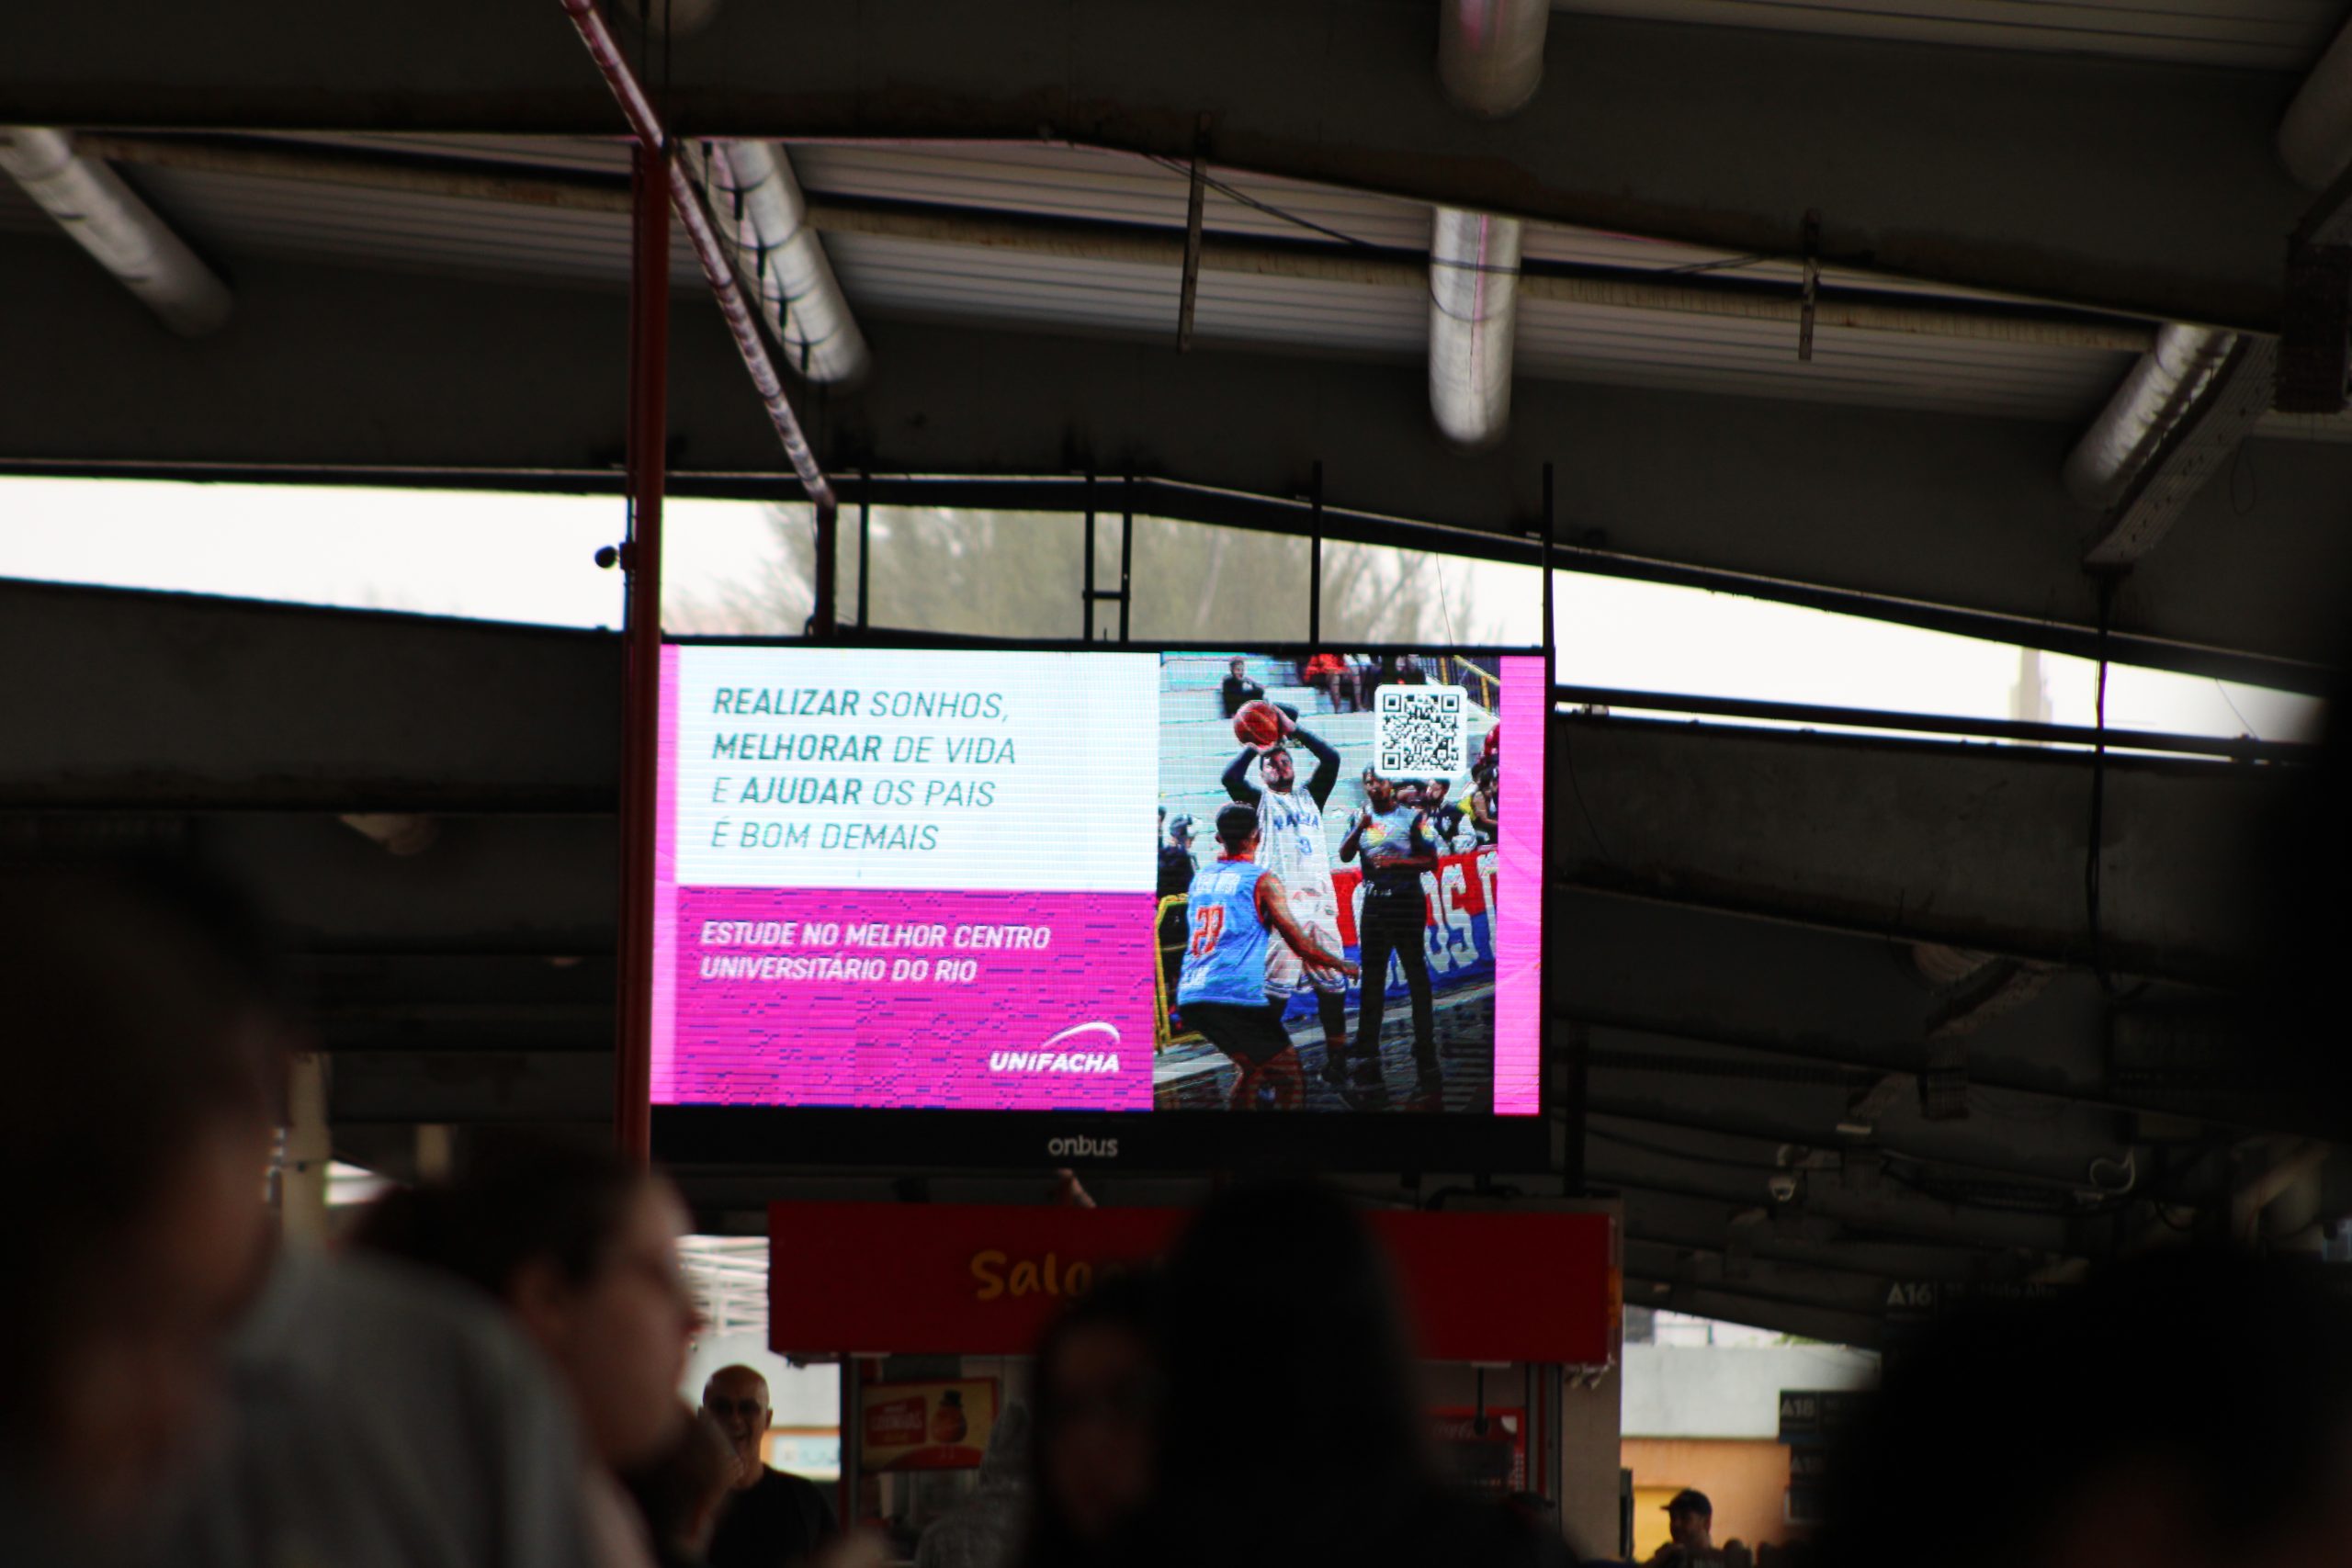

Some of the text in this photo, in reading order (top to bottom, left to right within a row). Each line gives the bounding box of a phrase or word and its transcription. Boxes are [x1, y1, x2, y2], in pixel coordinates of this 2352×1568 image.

[714, 687, 1009, 722] REALIZAR SONHOS,
[711, 733, 1016, 764] MELHORAR DE VIDA
[712, 776, 996, 807] E AJUDAR OS PAIS
[712, 816, 939, 851] É BOM DEMAIS
[700, 920, 1051, 951] ESTUDE NO MELHOR CENTRO
[699, 952, 978, 983] UNIVERSITÁRIO DO RIO
[989, 1050, 1121, 1073] UNIFACHA
[1047, 1134, 1119, 1157] onbus
[1886, 1280, 1933, 1306] A16
